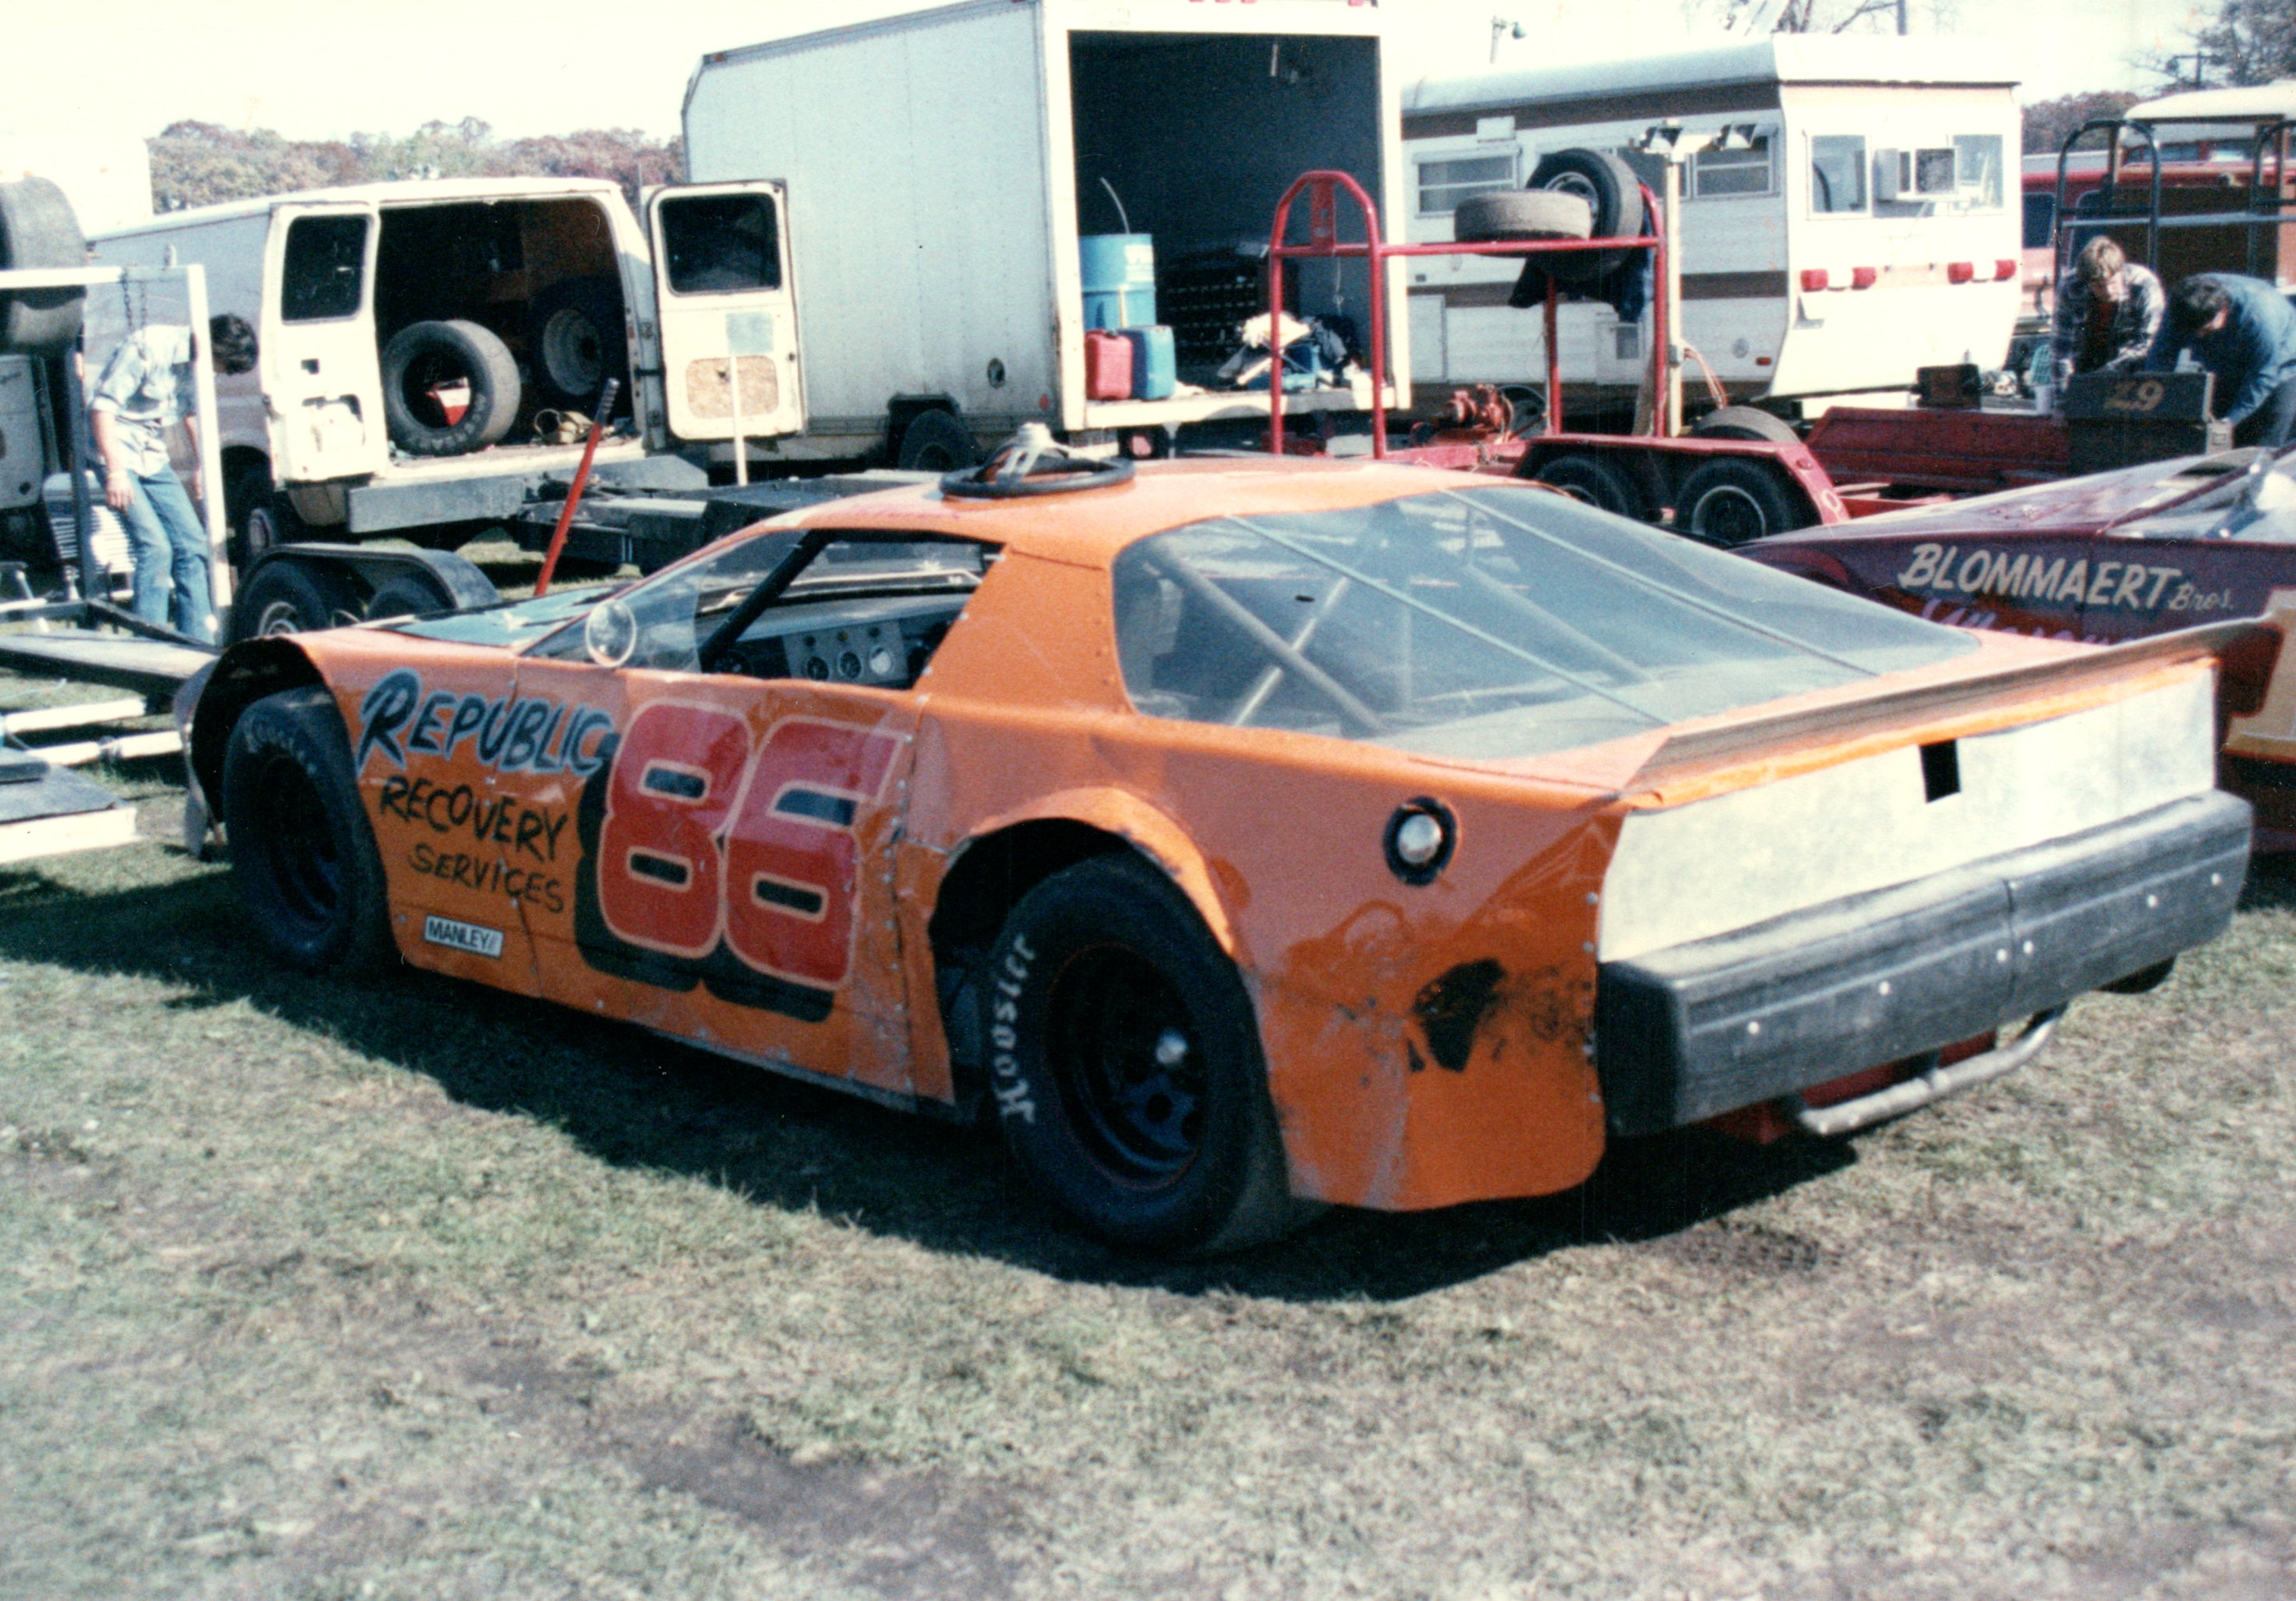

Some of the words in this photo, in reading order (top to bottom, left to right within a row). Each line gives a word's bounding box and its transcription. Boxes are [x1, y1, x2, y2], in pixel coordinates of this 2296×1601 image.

[1898, 543, 2182, 609] BLOMMAERT
[379, 775, 569, 862] RECOVERY
[408, 843, 565, 914] SERVICES
